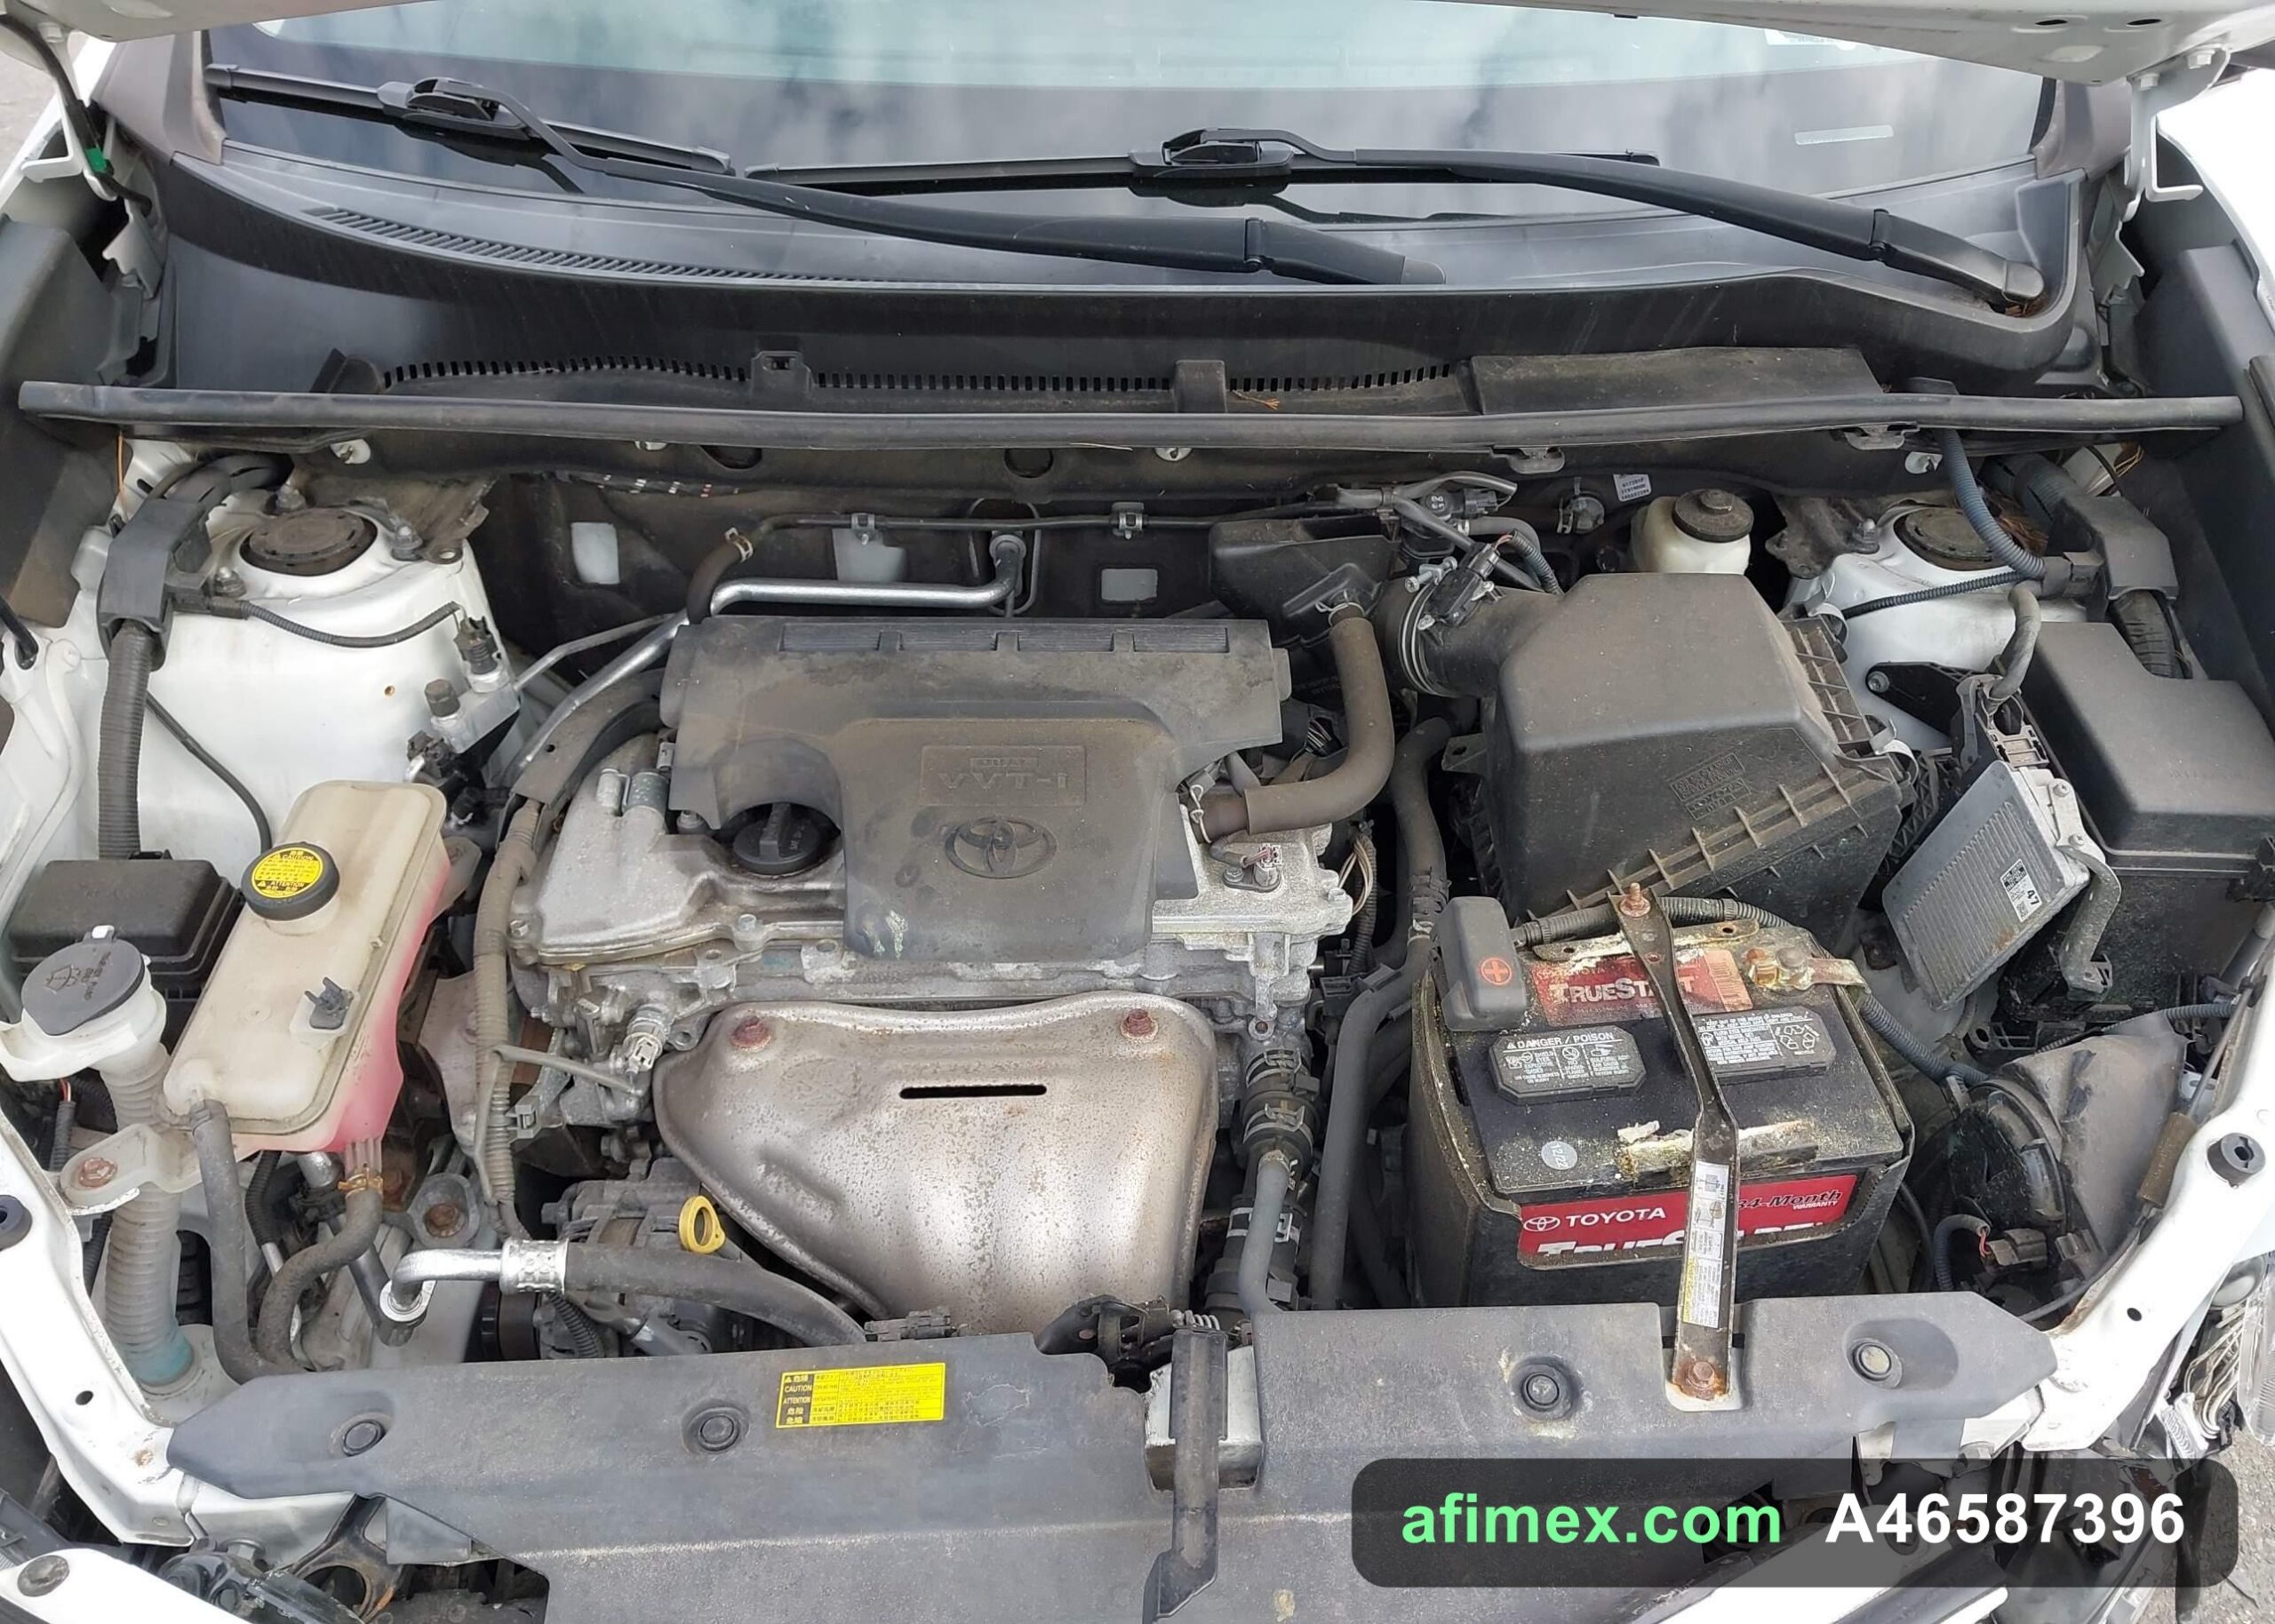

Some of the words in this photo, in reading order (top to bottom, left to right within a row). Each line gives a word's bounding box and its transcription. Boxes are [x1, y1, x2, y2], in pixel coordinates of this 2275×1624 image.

[2027, 889, 2040, 905] 47
[1549, 976, 1699, 1004] TRUESTT
[1516, 1037, 1562, 1049] DANGER
[1572, 1031, 1616, 1044] POISON
[1550, 1142, 1569, 1168] 12/22
[1792, 1200, 1839, 1210] WARRANTY
[1565, 1207, 1666, 1228] TOYOTA
[784, 1384, 813, 1393] CAUTION
[782, 1396, 811, 1405] ATTENTION
